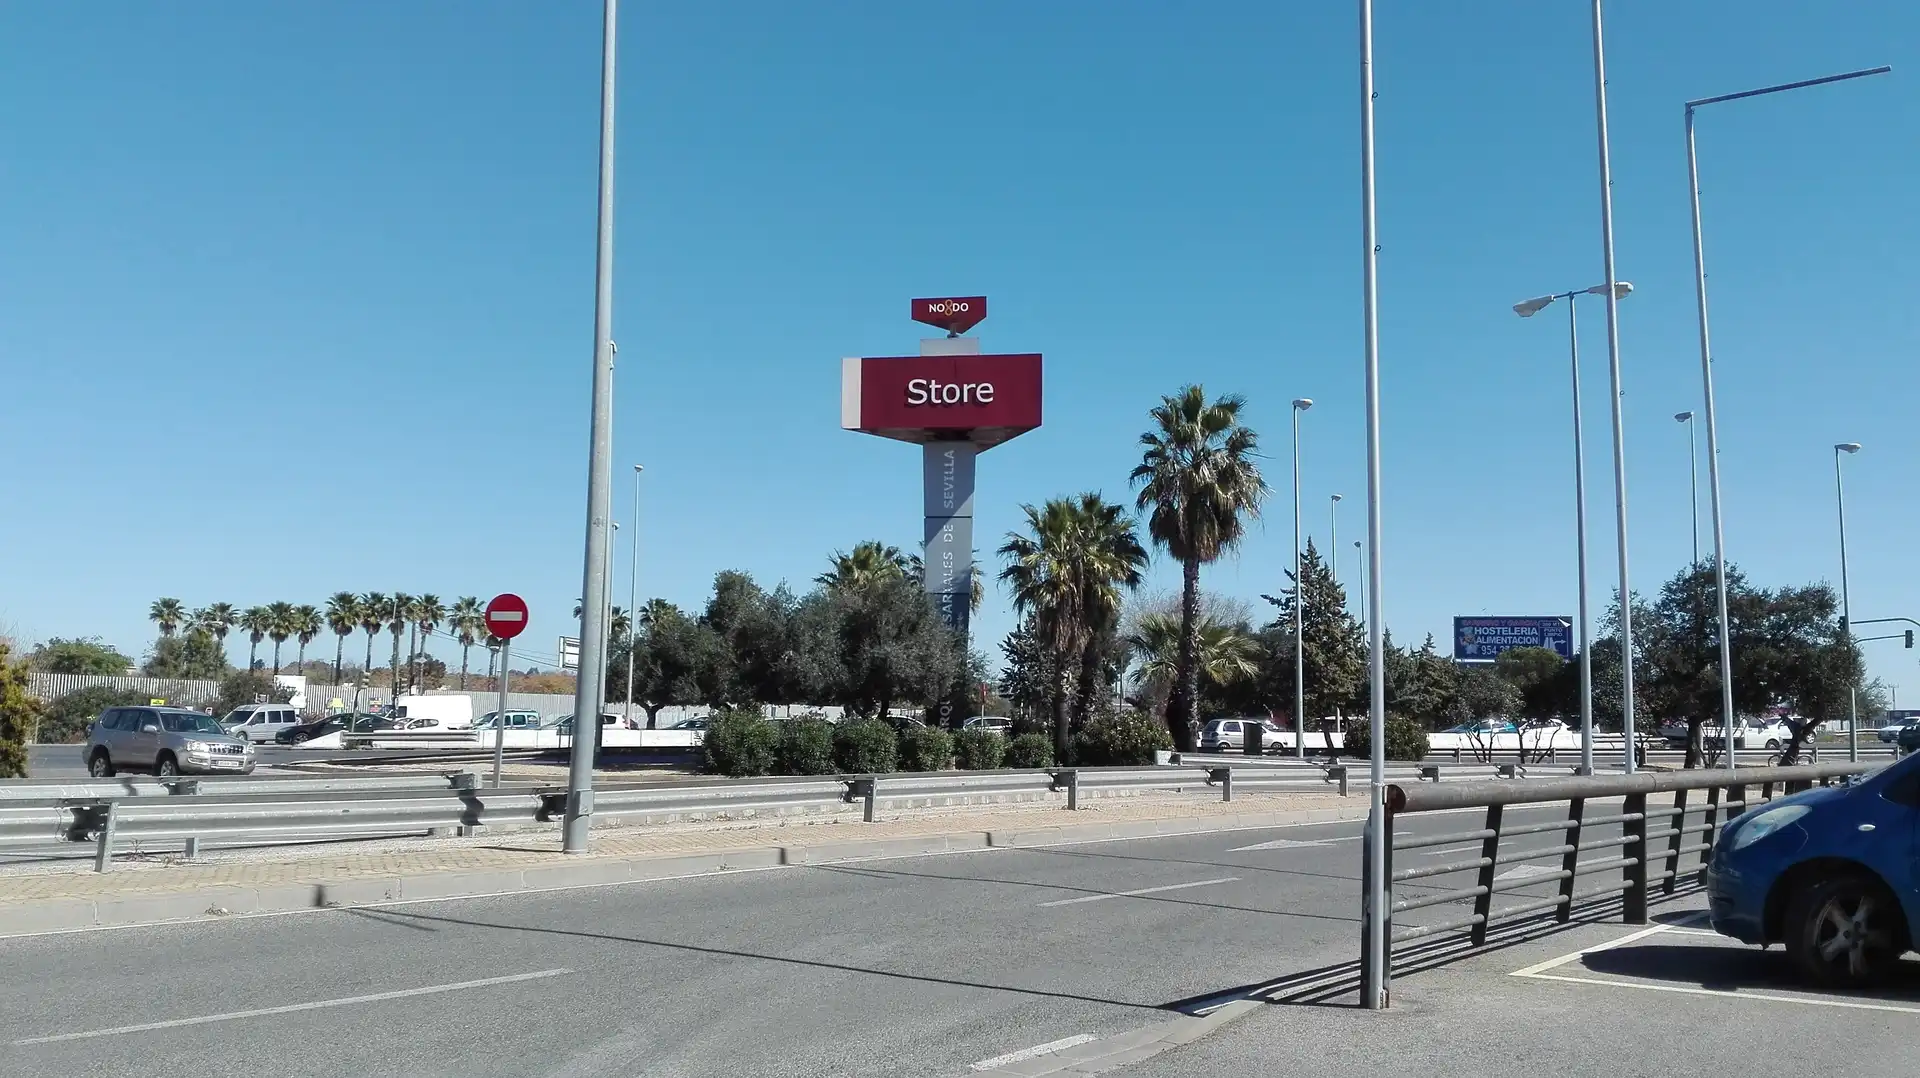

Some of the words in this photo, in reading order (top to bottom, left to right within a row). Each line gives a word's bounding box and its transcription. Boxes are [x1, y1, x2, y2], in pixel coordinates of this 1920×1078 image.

[907, 378, 994, 405] Store
[943, 450, 954, 509] SEVILLA
[943, 524, 953, 543] DE
[1474, 626, 1538, 636] HOSTELERIA
[1475, 636, 1539, 645] ALIMENTACION
[1481, 645, 1497, 655] 954
